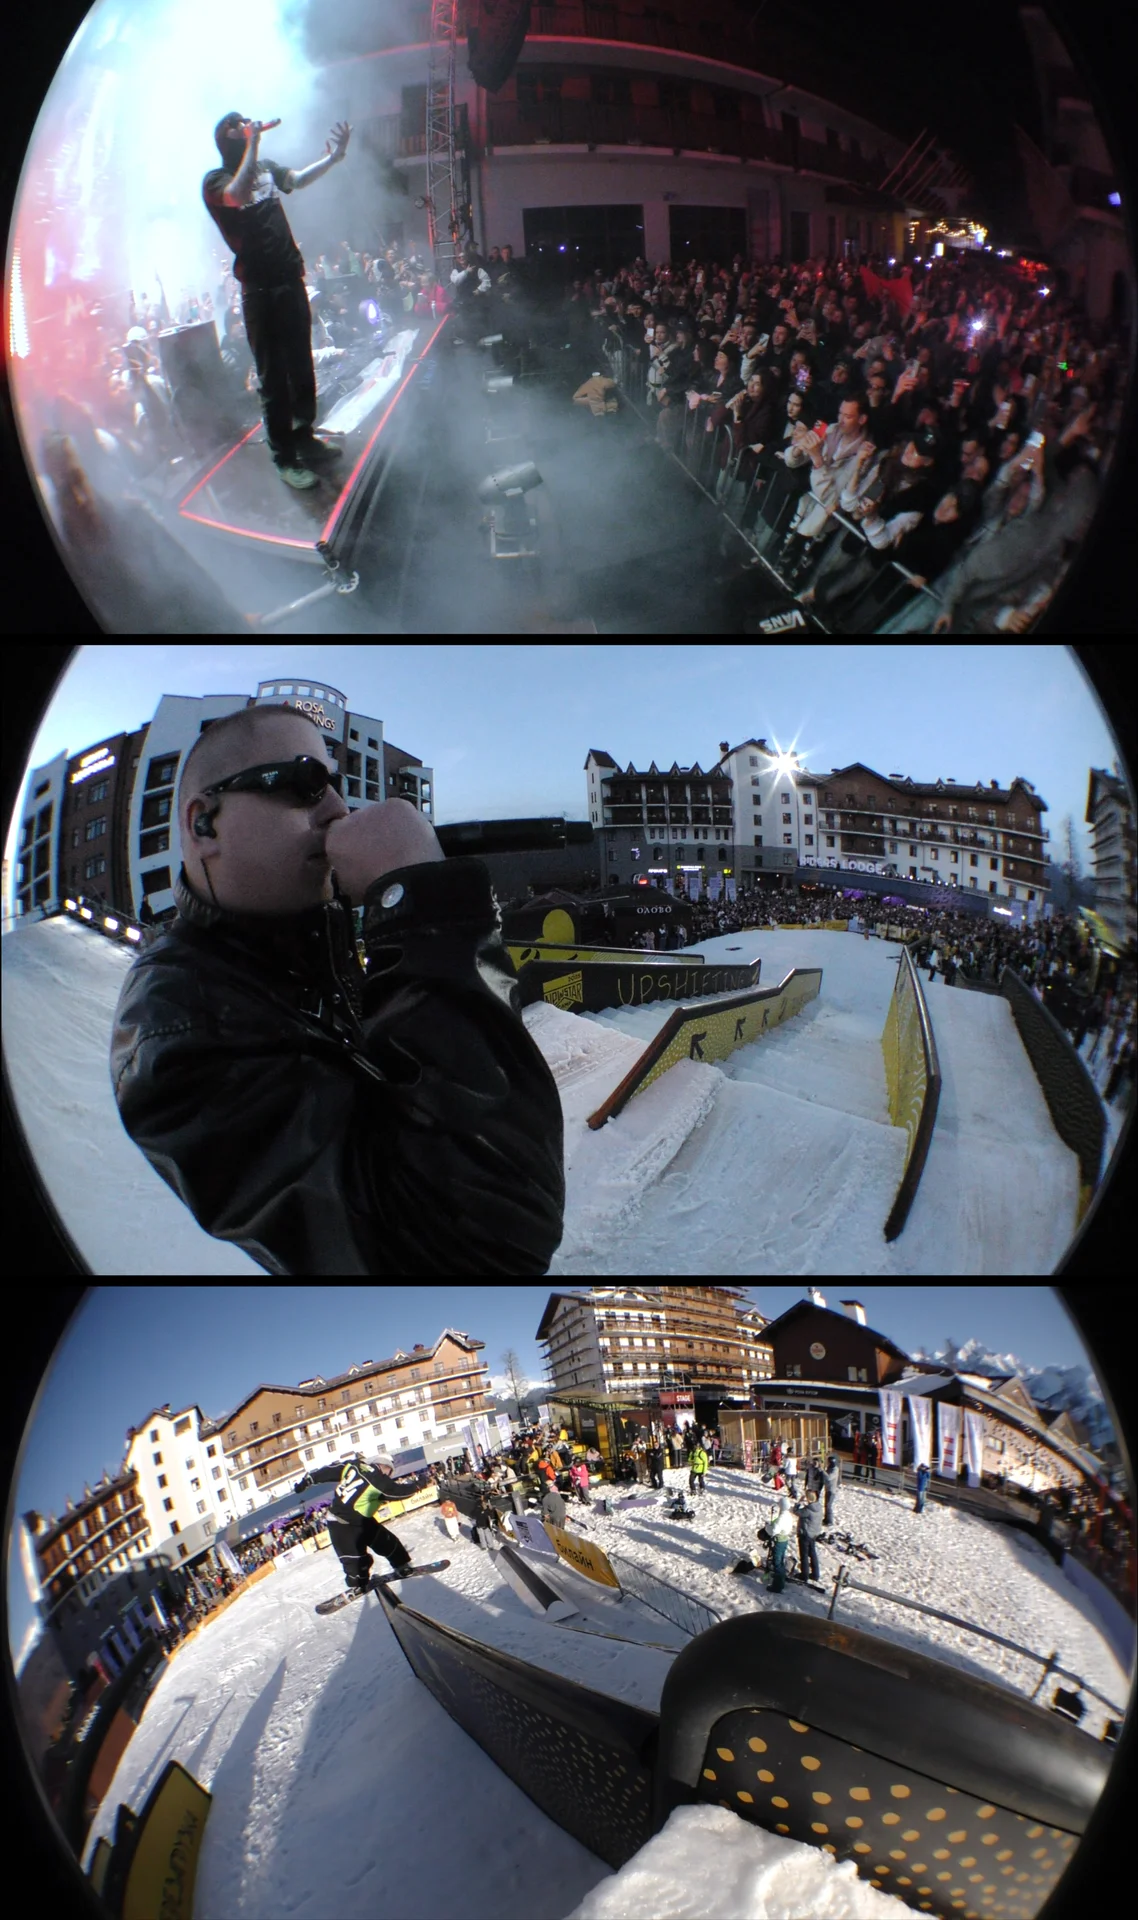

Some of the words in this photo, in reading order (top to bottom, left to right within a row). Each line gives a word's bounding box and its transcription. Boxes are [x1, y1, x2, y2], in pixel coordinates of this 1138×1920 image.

[759, 609, 806, 634] VANS
[295, 700, 325, 715] ROSA
[842, 859, 883, 875] LODGE
[556, 1539, 594, 1571] билайн
